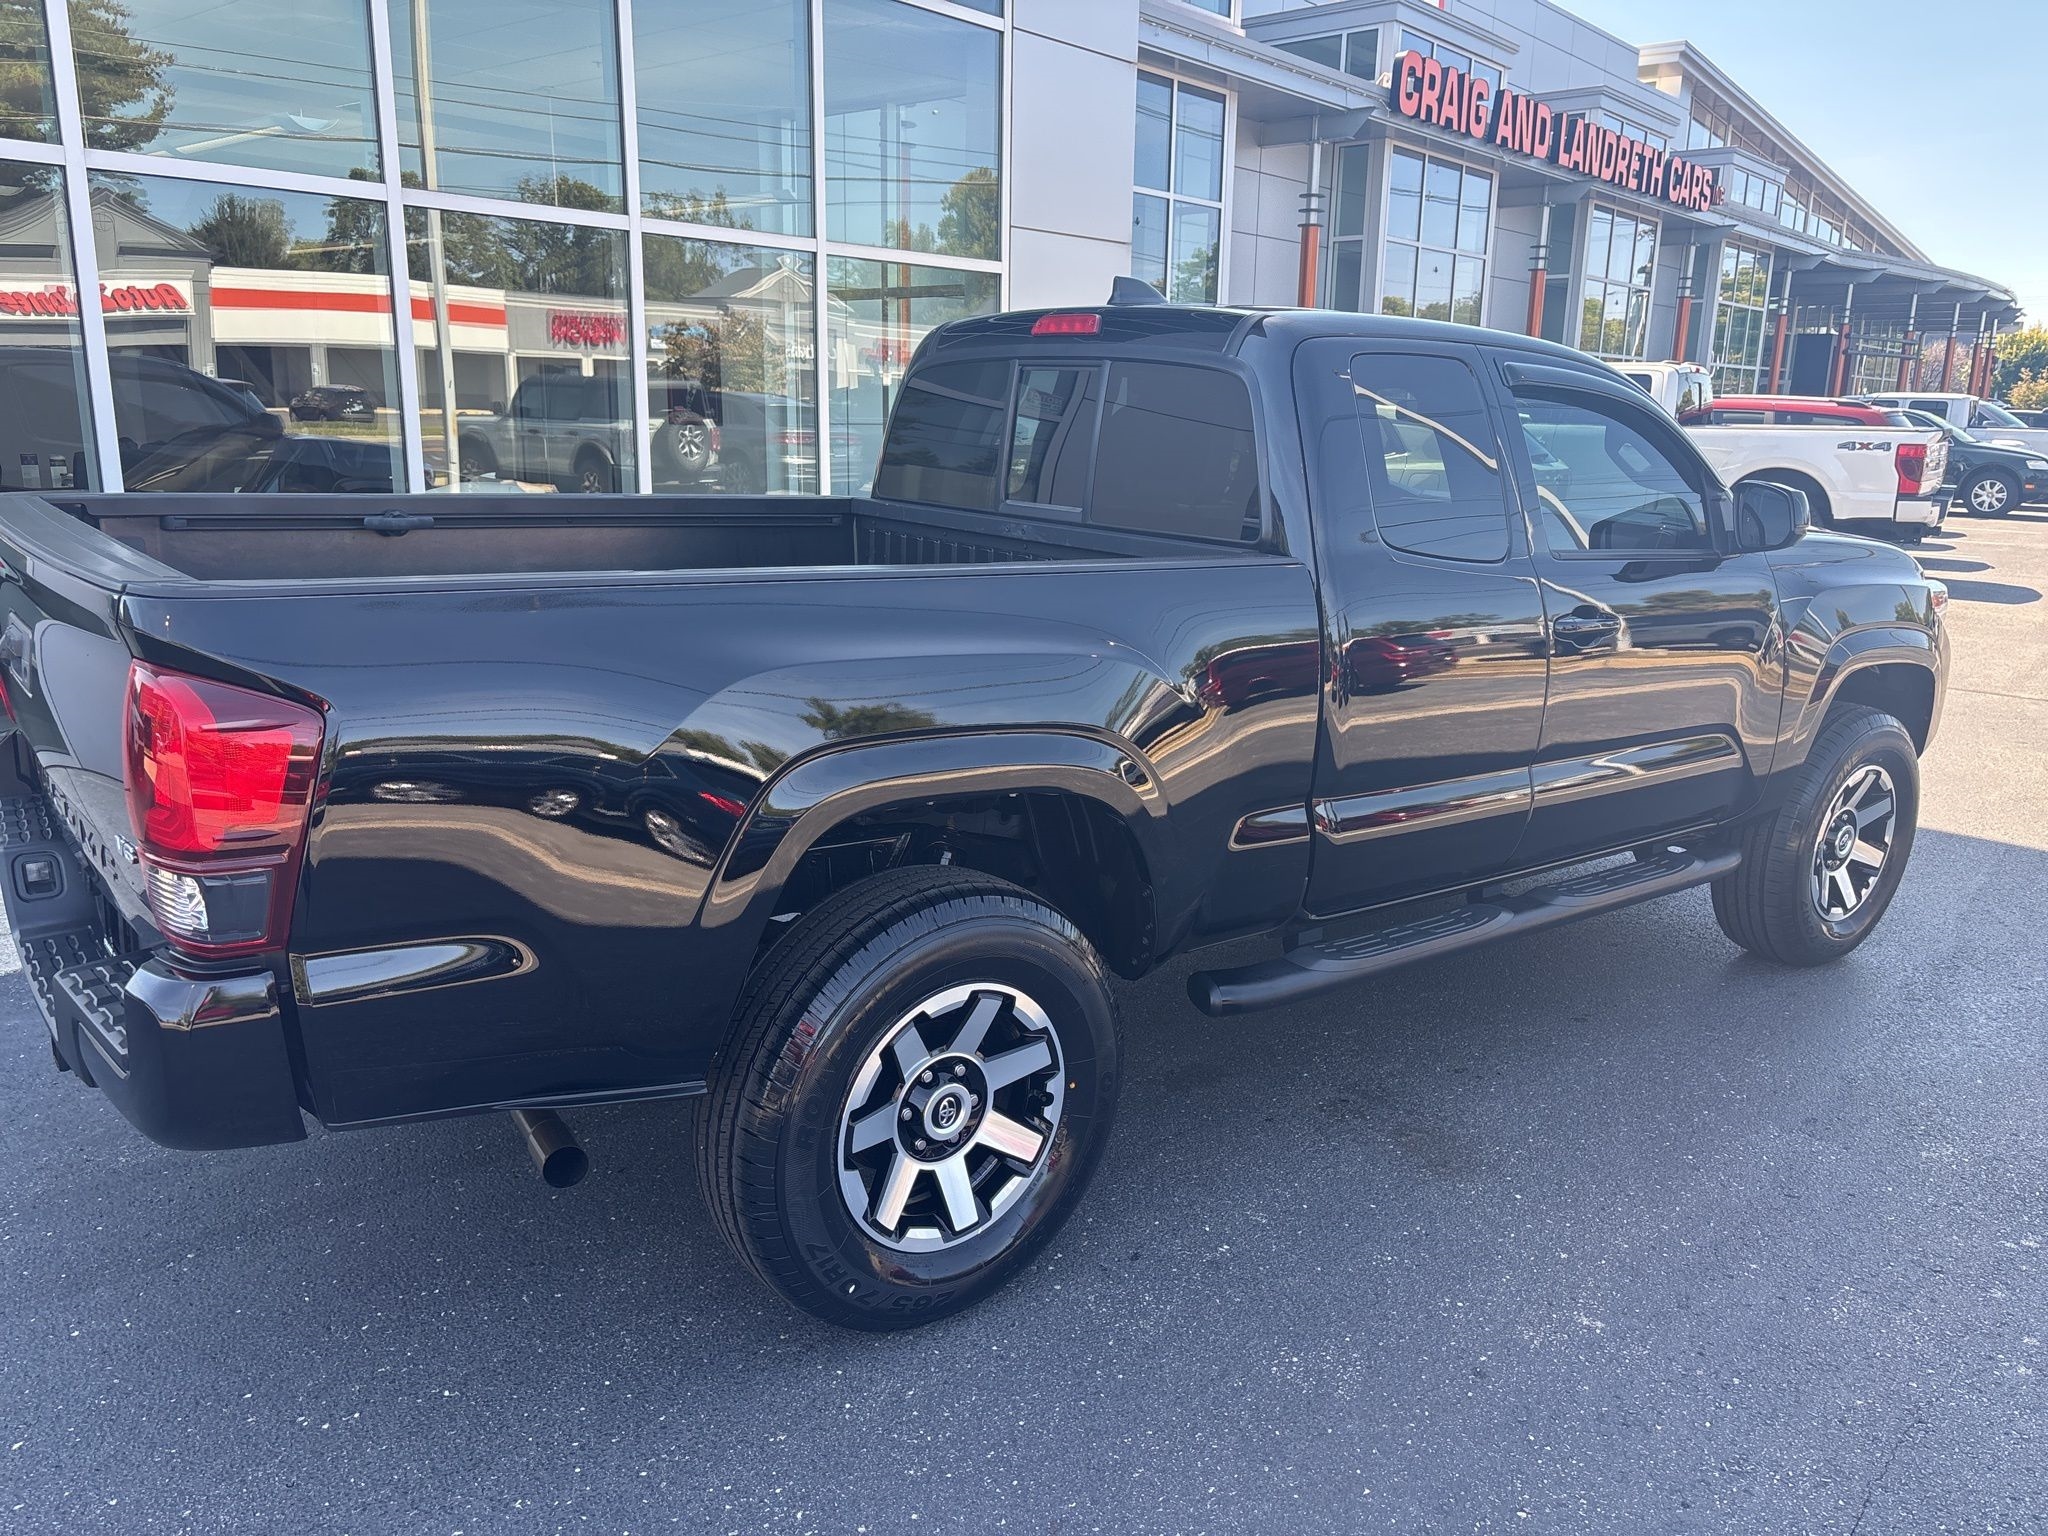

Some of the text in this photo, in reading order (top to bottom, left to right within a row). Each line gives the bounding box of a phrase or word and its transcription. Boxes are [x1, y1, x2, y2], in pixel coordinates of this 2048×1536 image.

[1393, 50, 1489, 139] CRAIG
[1496, 89, 1551, 159] AND
[1555, 112, 1664, 196] LANDRETH
[1669, 156, 1712, 212] CARS
